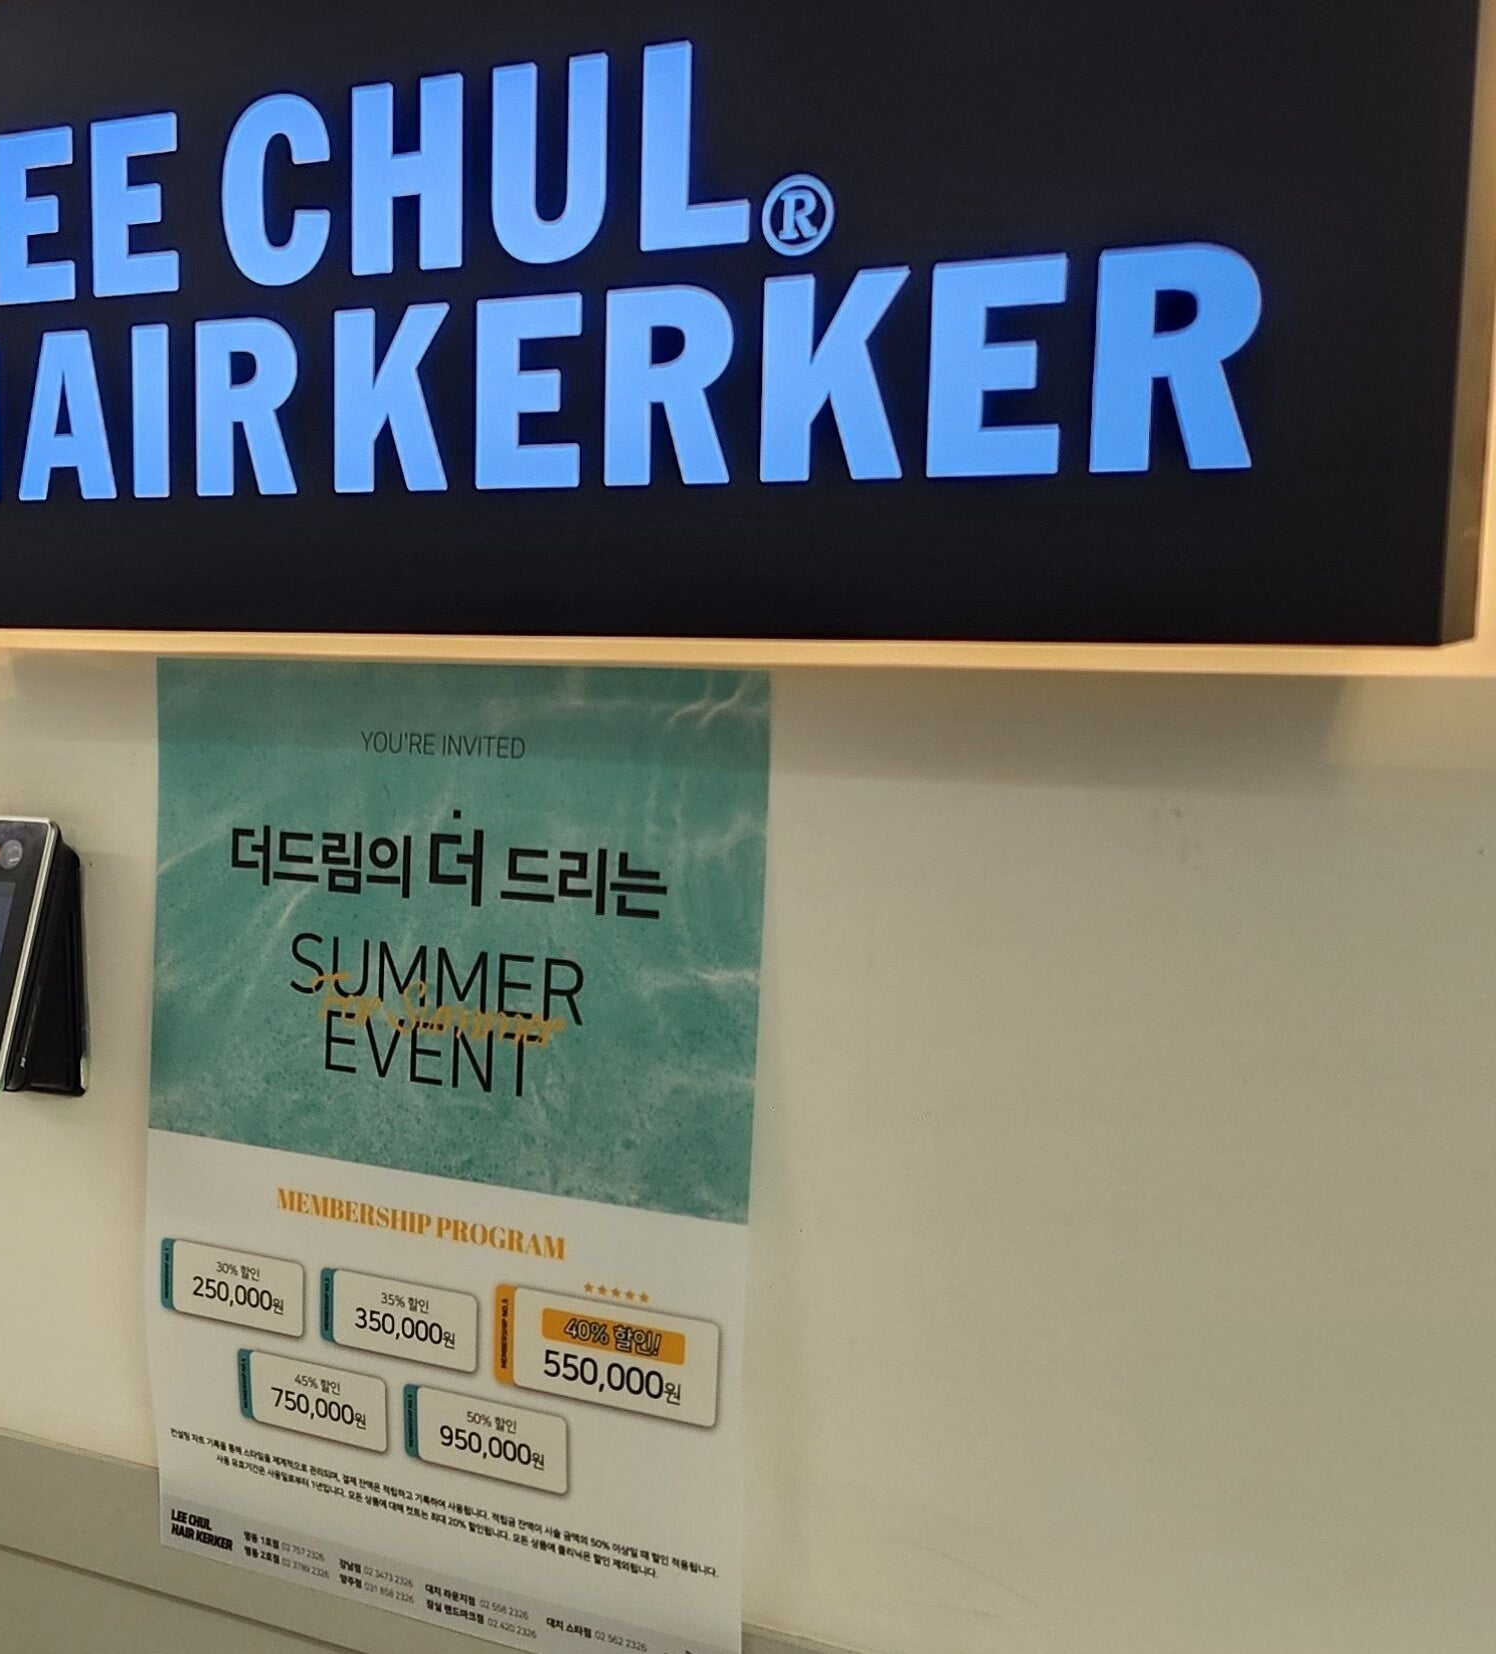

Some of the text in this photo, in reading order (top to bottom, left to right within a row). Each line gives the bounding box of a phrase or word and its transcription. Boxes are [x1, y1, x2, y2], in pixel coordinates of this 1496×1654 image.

[335, 244, 1262, 493] KERKER
[361, 729, 529, 759] YOU'RE INVITED
[231, 809, 668, 919] 더드림의 더 드리는
[290, 932, 584, 1026] SUMMER
[324, 1010, 545, 1097] EVENT
[277, 1188, 567, 1261] MEMBERSHIP PROGRAM
[216, 1261, 260, 1281] 30% 할인
[381, 1292, 429, 1314] 35% 할인
[564, 1318, 662, 1357] 40% 할인!
[294, 1375, 340, 1396] 45% 할인
[467, 1411, 516, 1434] 50% 할인
[171, 1509, 212, 1531] LEE CHUL
[171, 1523, 232, 1551] HAIR KERKER
